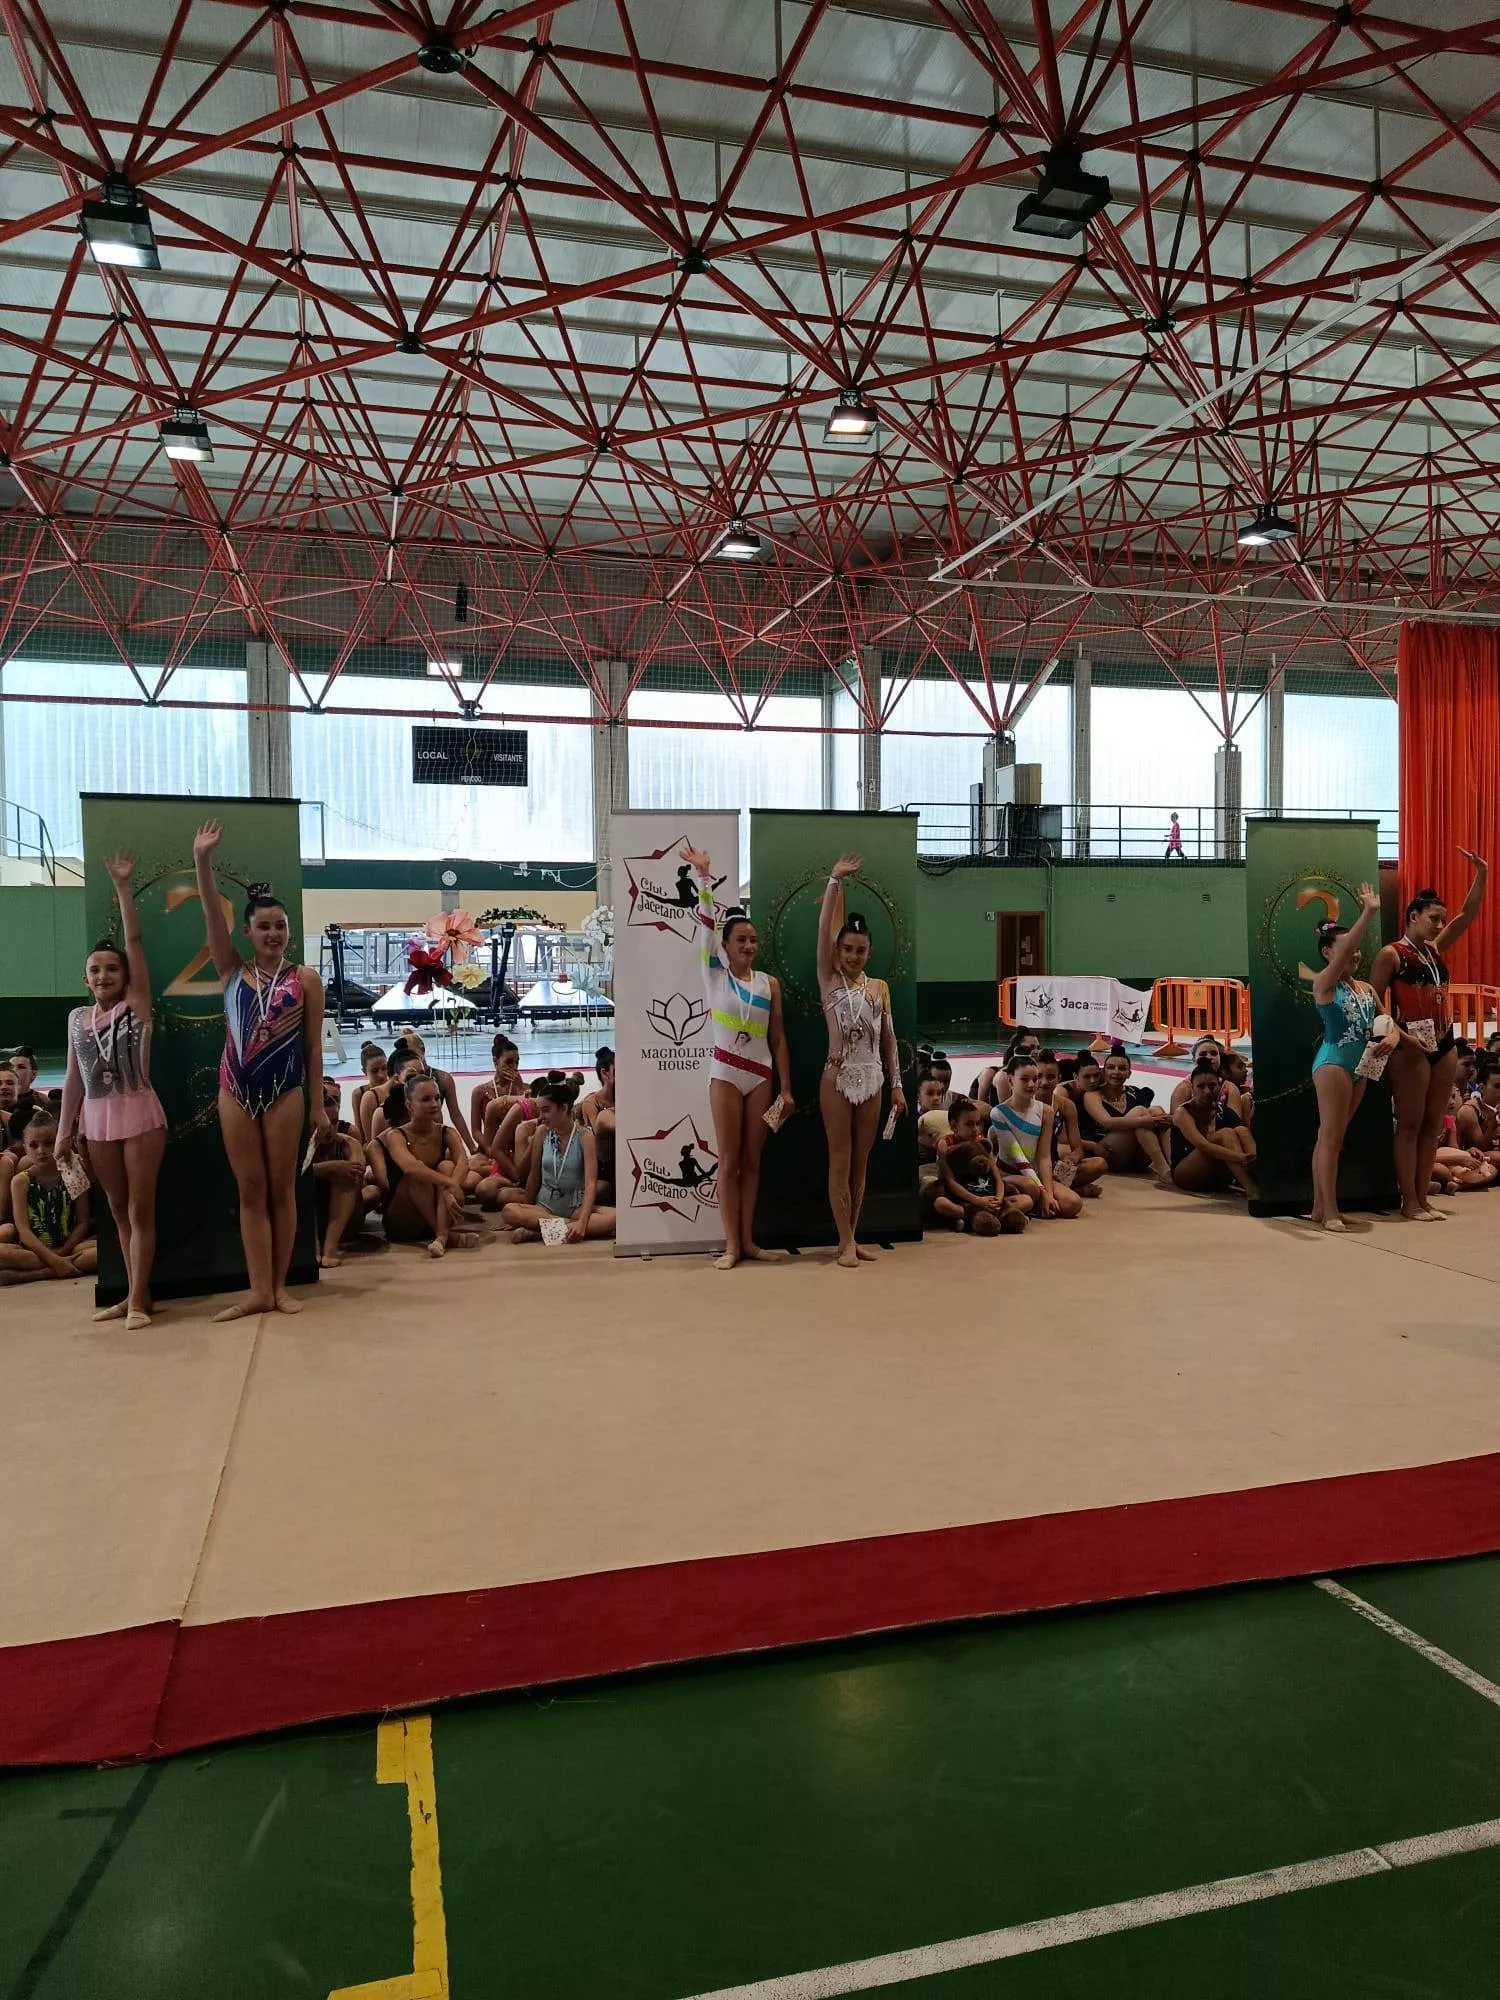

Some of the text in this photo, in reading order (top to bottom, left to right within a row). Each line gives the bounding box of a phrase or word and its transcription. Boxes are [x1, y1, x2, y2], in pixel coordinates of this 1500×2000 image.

[417, 751, 448, 760] LOCAL
[493, 753, 523, 763] VISITANTE
[640, 877, 667, 896] Club
[637, 895, 685, 919] Jacetano
[162, 886, 236, 996] 2
[1060, 997, 1089, 1010] Jaca
[643, 1158, 670, 1176] Club
[640, 1175, 687, 1199] Jacetano
